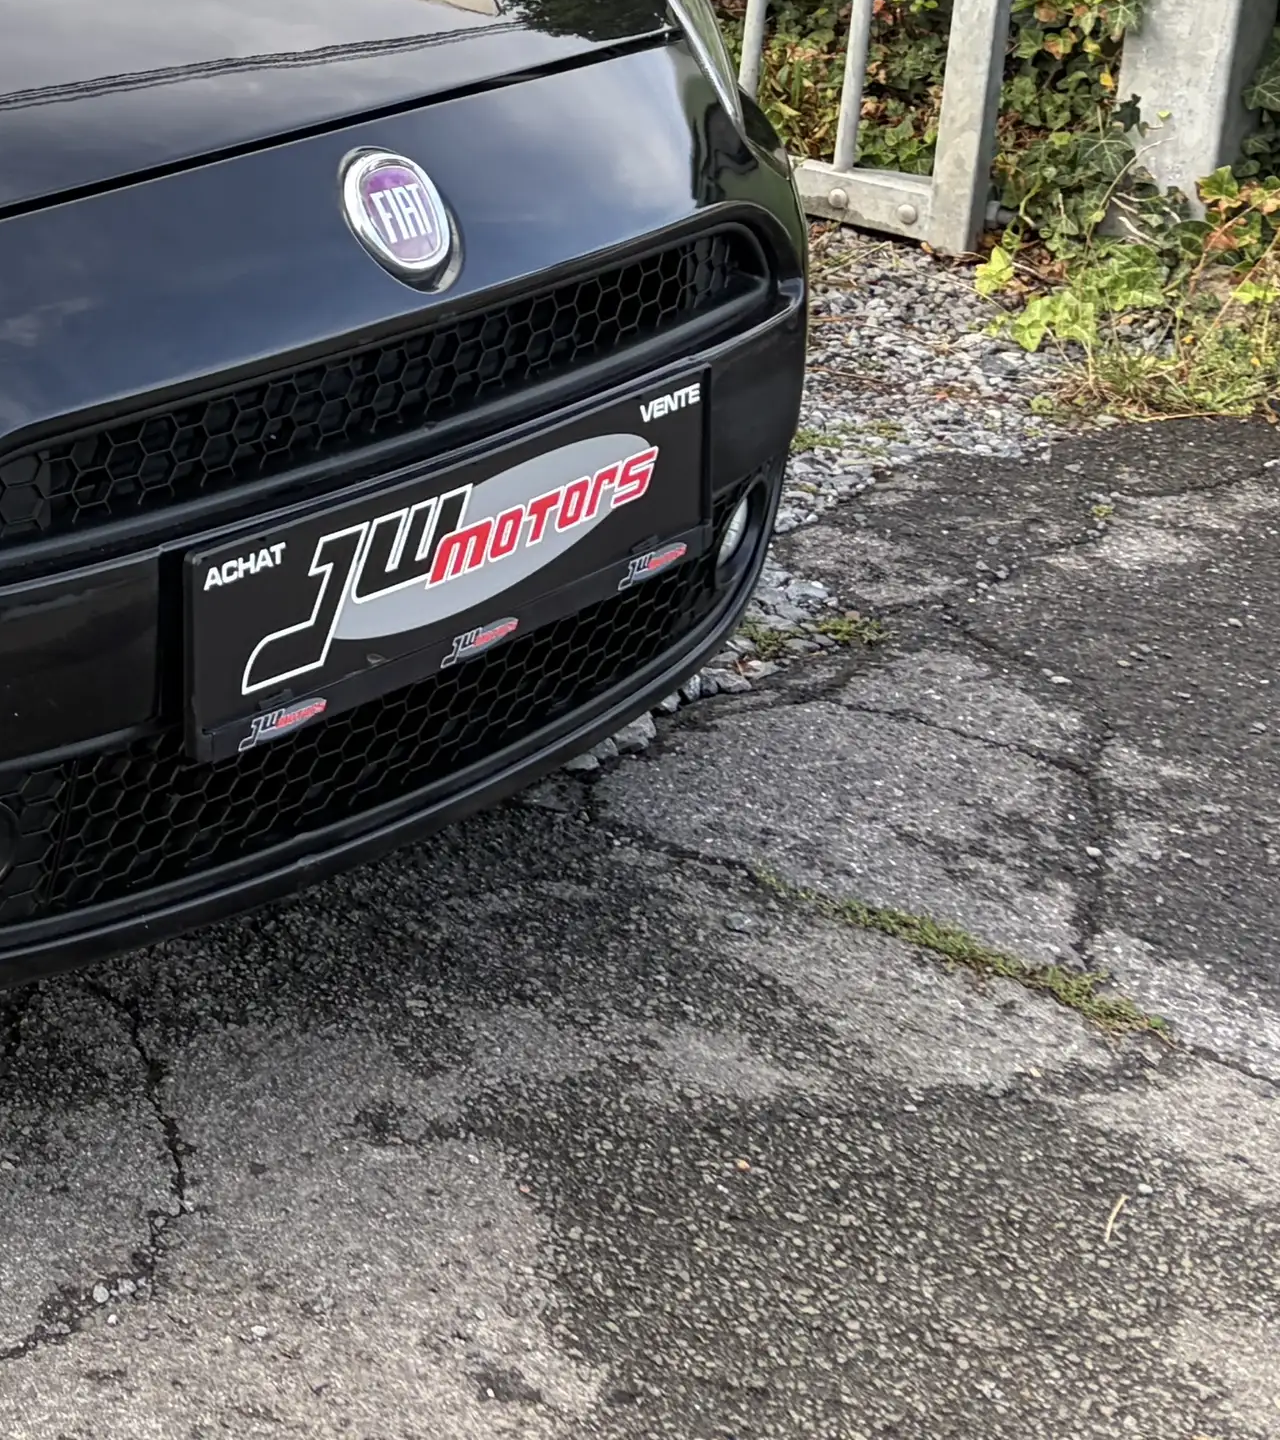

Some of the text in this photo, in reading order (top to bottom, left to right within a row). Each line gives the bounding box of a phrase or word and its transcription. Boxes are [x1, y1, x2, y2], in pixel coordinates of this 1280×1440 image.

[369, 183, 432, 244] FIAT
[640, 383, 700, 423] VENTE
[204, 542, 286, 590] ACHAT
[242, 483, 473, 695] JW
